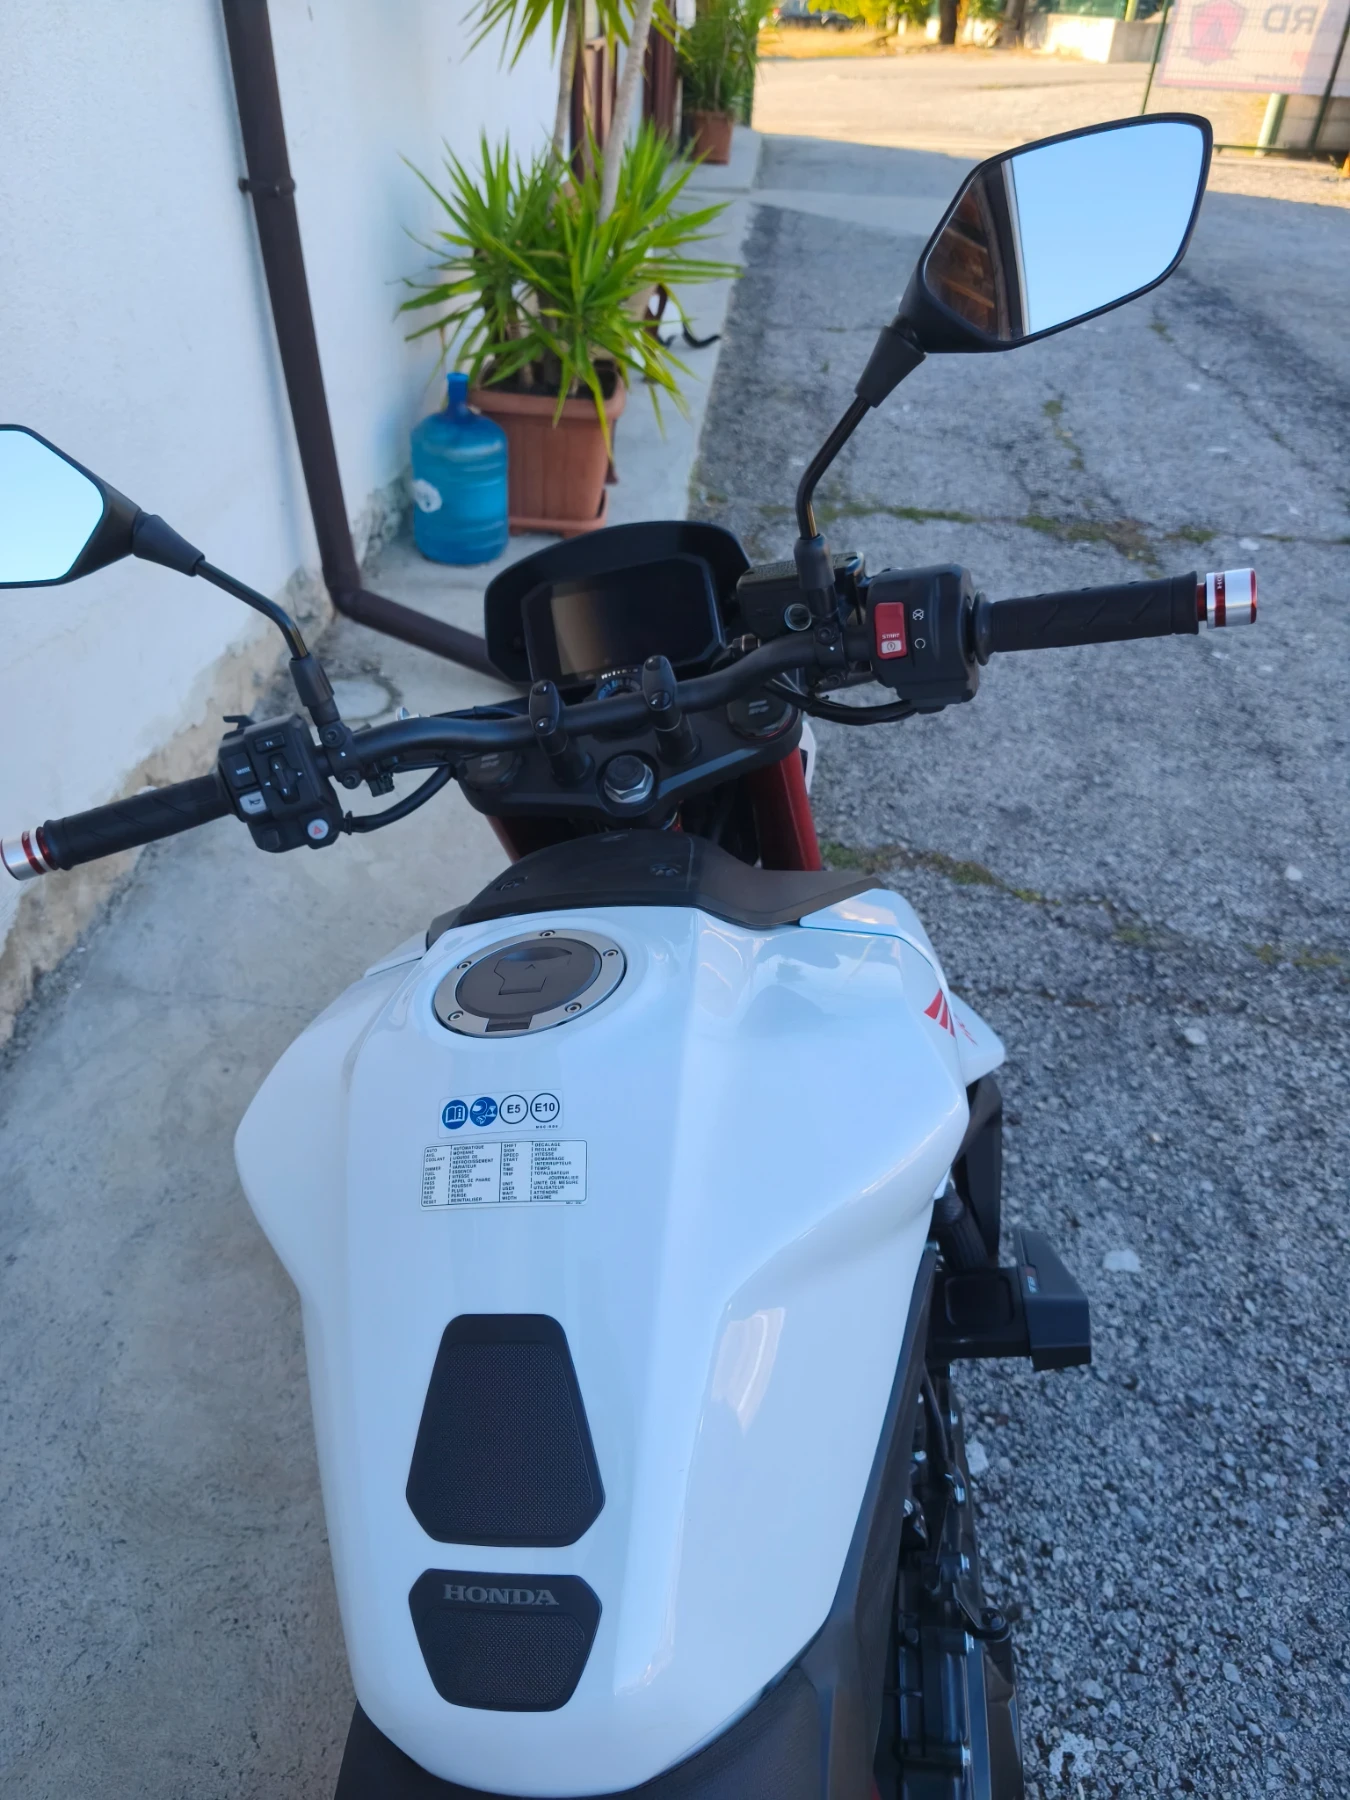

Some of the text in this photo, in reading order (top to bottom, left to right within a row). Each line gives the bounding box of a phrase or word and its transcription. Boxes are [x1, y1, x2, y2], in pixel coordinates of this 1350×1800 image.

[507, 1104, 521, 1114] E5
[535, 1102, 555, 1112] E10
[442, 1584, 559, 1606] HONDA
